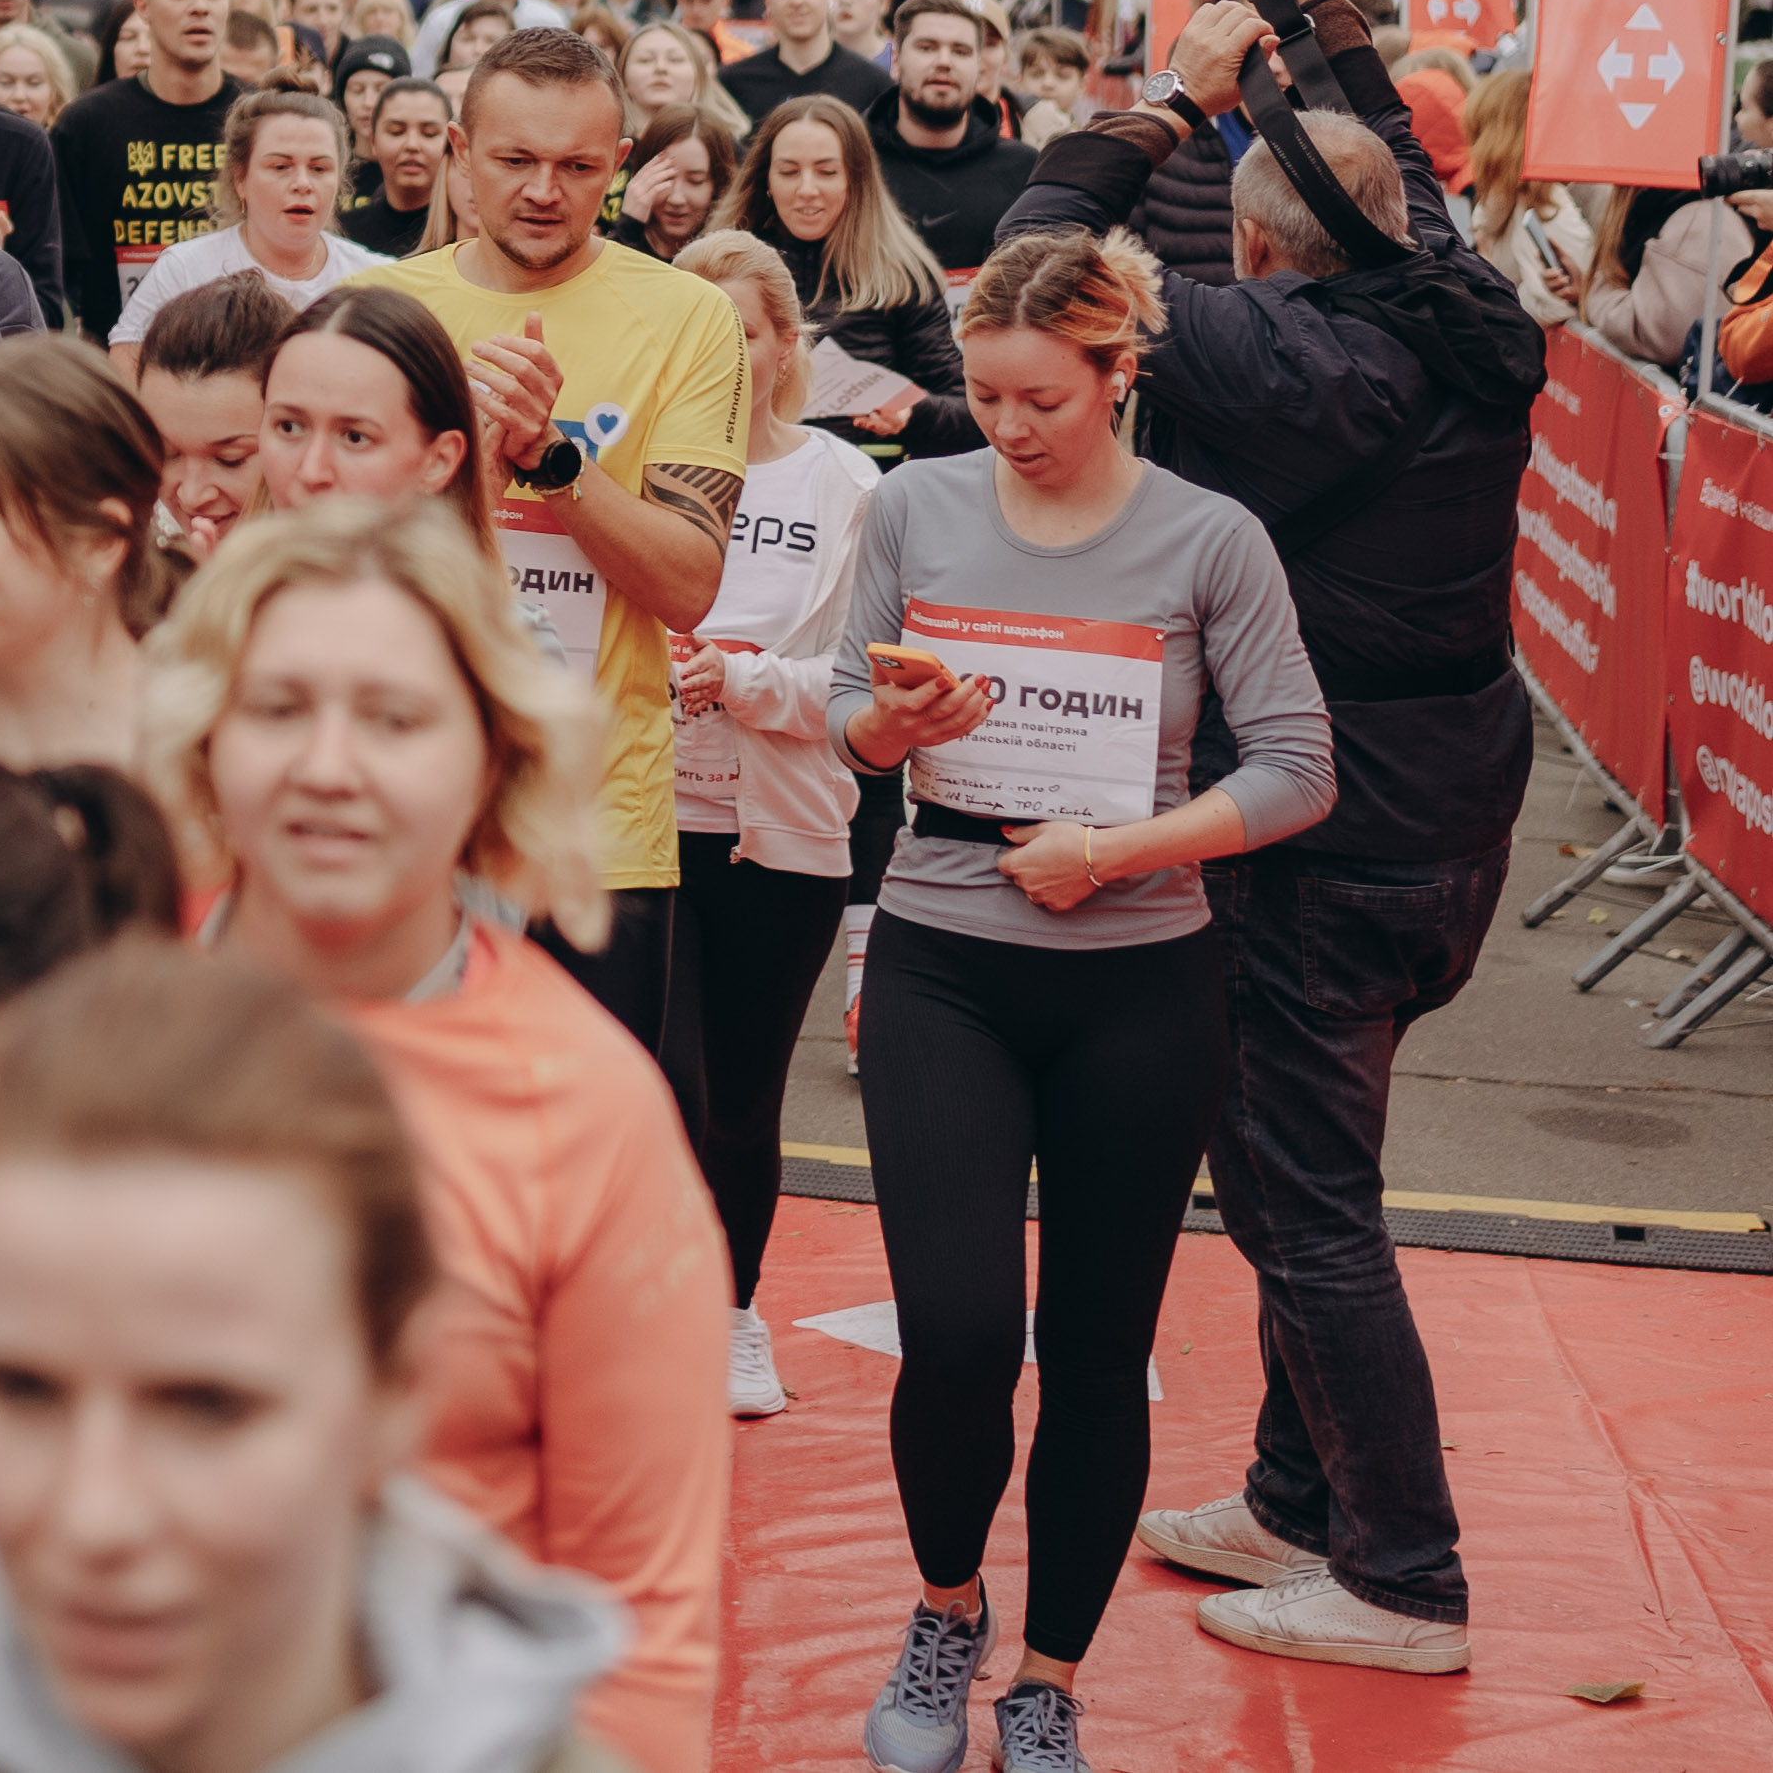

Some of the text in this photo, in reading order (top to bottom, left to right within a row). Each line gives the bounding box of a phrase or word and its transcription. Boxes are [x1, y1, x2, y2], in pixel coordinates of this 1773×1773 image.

[161, 143, 228, 171] FREE
[491, 508, 524, 521] афон
[1003, 624, 1065, 641] марафон
[1019, 684, 1143, 721] годин
[1021, 721, 1088, 737] повітряна
[1026, 737, 1077, 753] області
